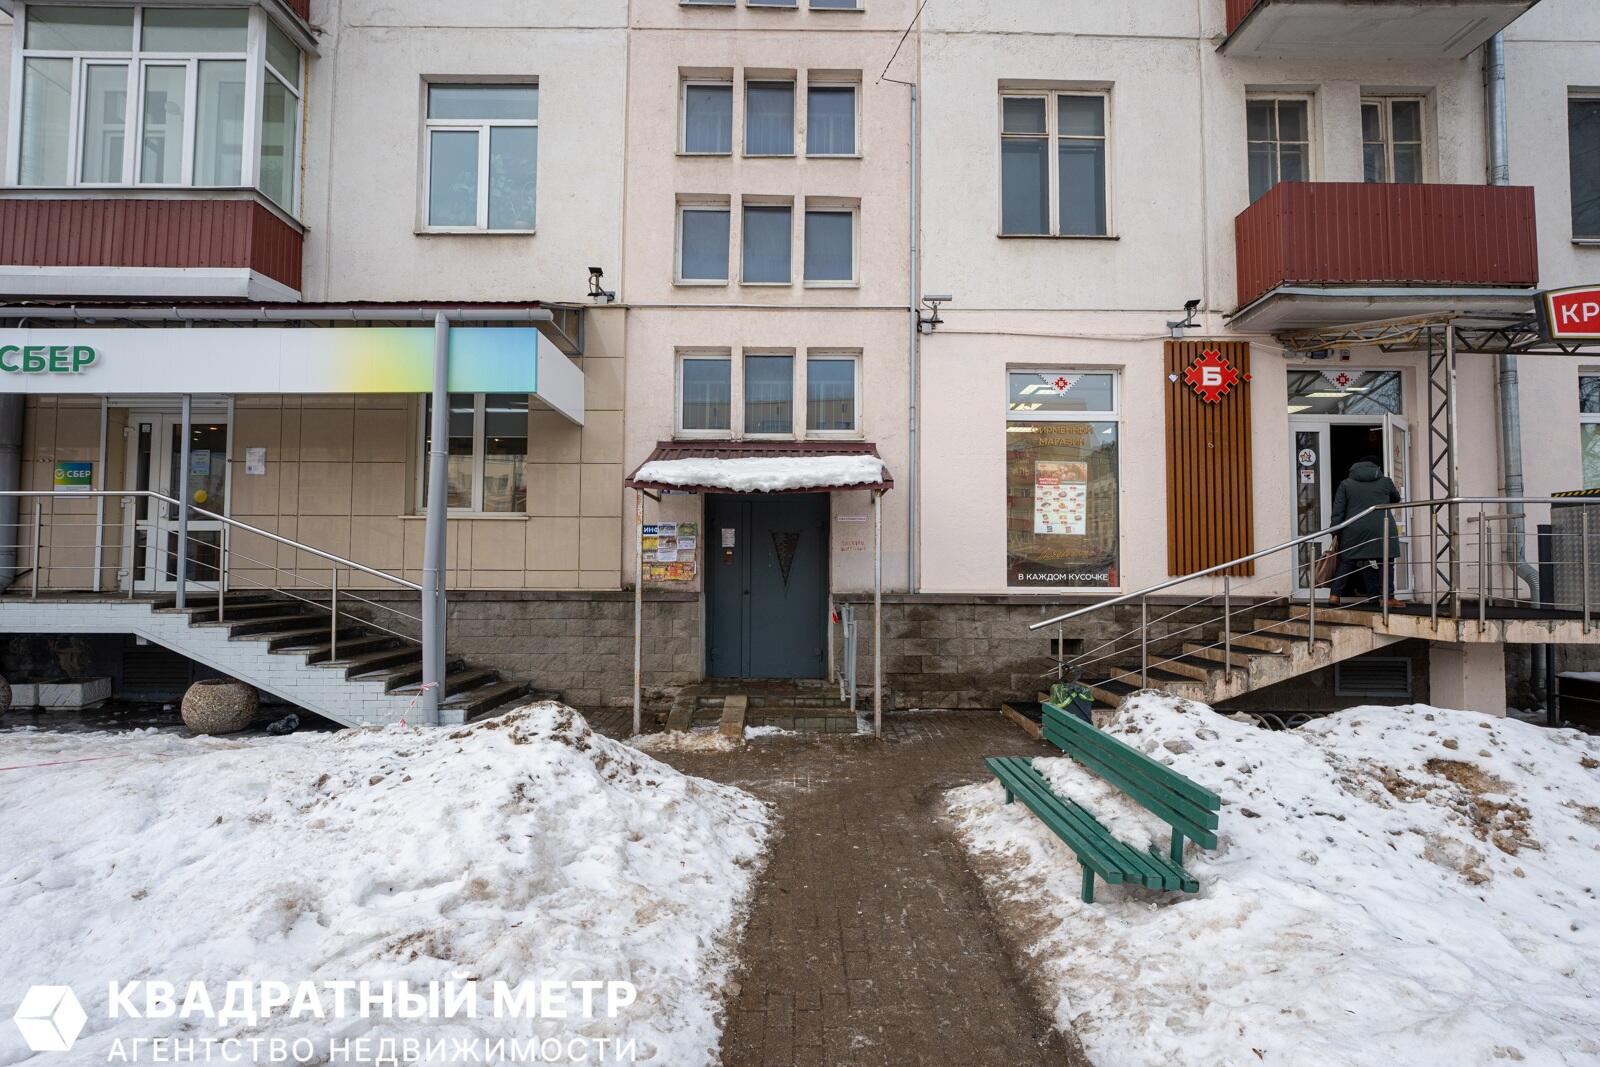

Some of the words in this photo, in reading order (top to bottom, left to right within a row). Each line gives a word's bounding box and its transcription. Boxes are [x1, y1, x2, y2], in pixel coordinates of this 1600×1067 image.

[0, 344, 96, 373] СБЕР
[1202, 366, 1222, 387] Б
[66, 470, 91, 478] СБЕР
[1026, 573, 1066, 581] КАЖДОМ
[1068, 573, 1108, 581] КУСОЧКЕ
